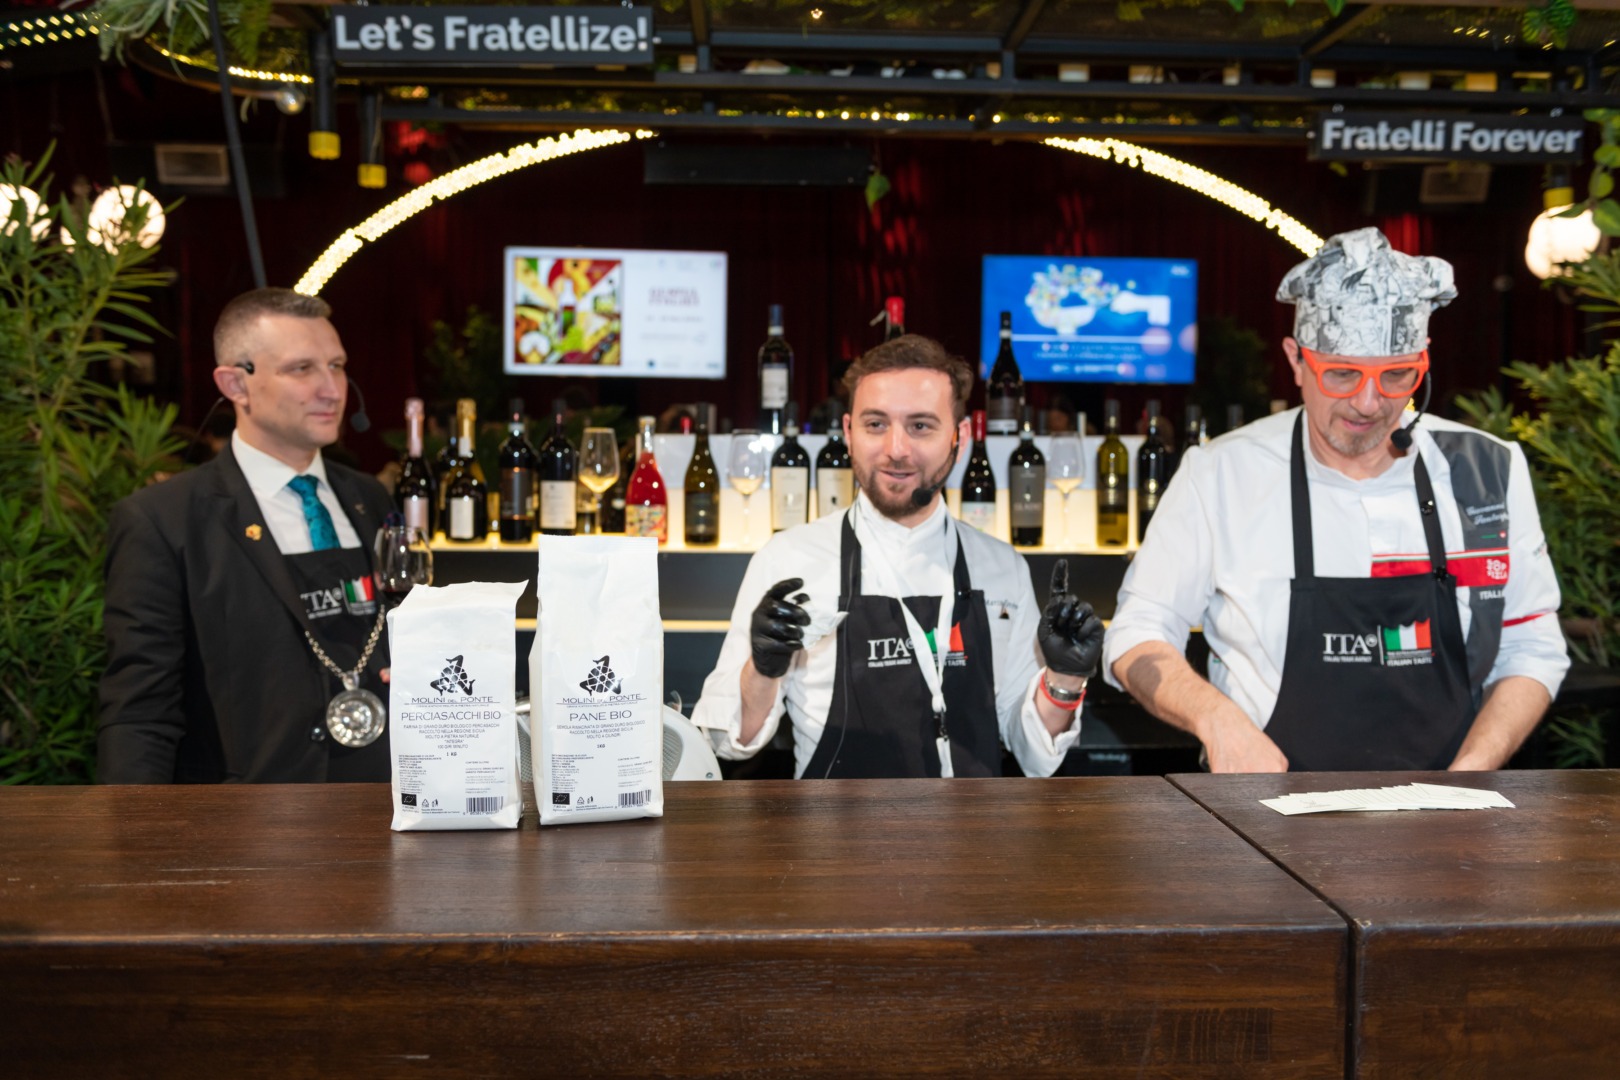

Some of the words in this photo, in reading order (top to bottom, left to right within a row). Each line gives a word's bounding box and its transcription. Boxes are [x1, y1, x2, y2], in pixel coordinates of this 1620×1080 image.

[335, 15, 435, 50] Let's
[444, 15, 649, 51] Fratellize!
[1322, 119, 1446, 151] Fratelli
[1452, 121, 1582, 153] Forever
[609, 694, 641, 702] PONTE
[401, 711, 481, 721] PERCIASACCHI
[483, 710, 501, 720] BIO
[570, 712, 607, 722] PANE
[610, 710, 632, 720] BIO
